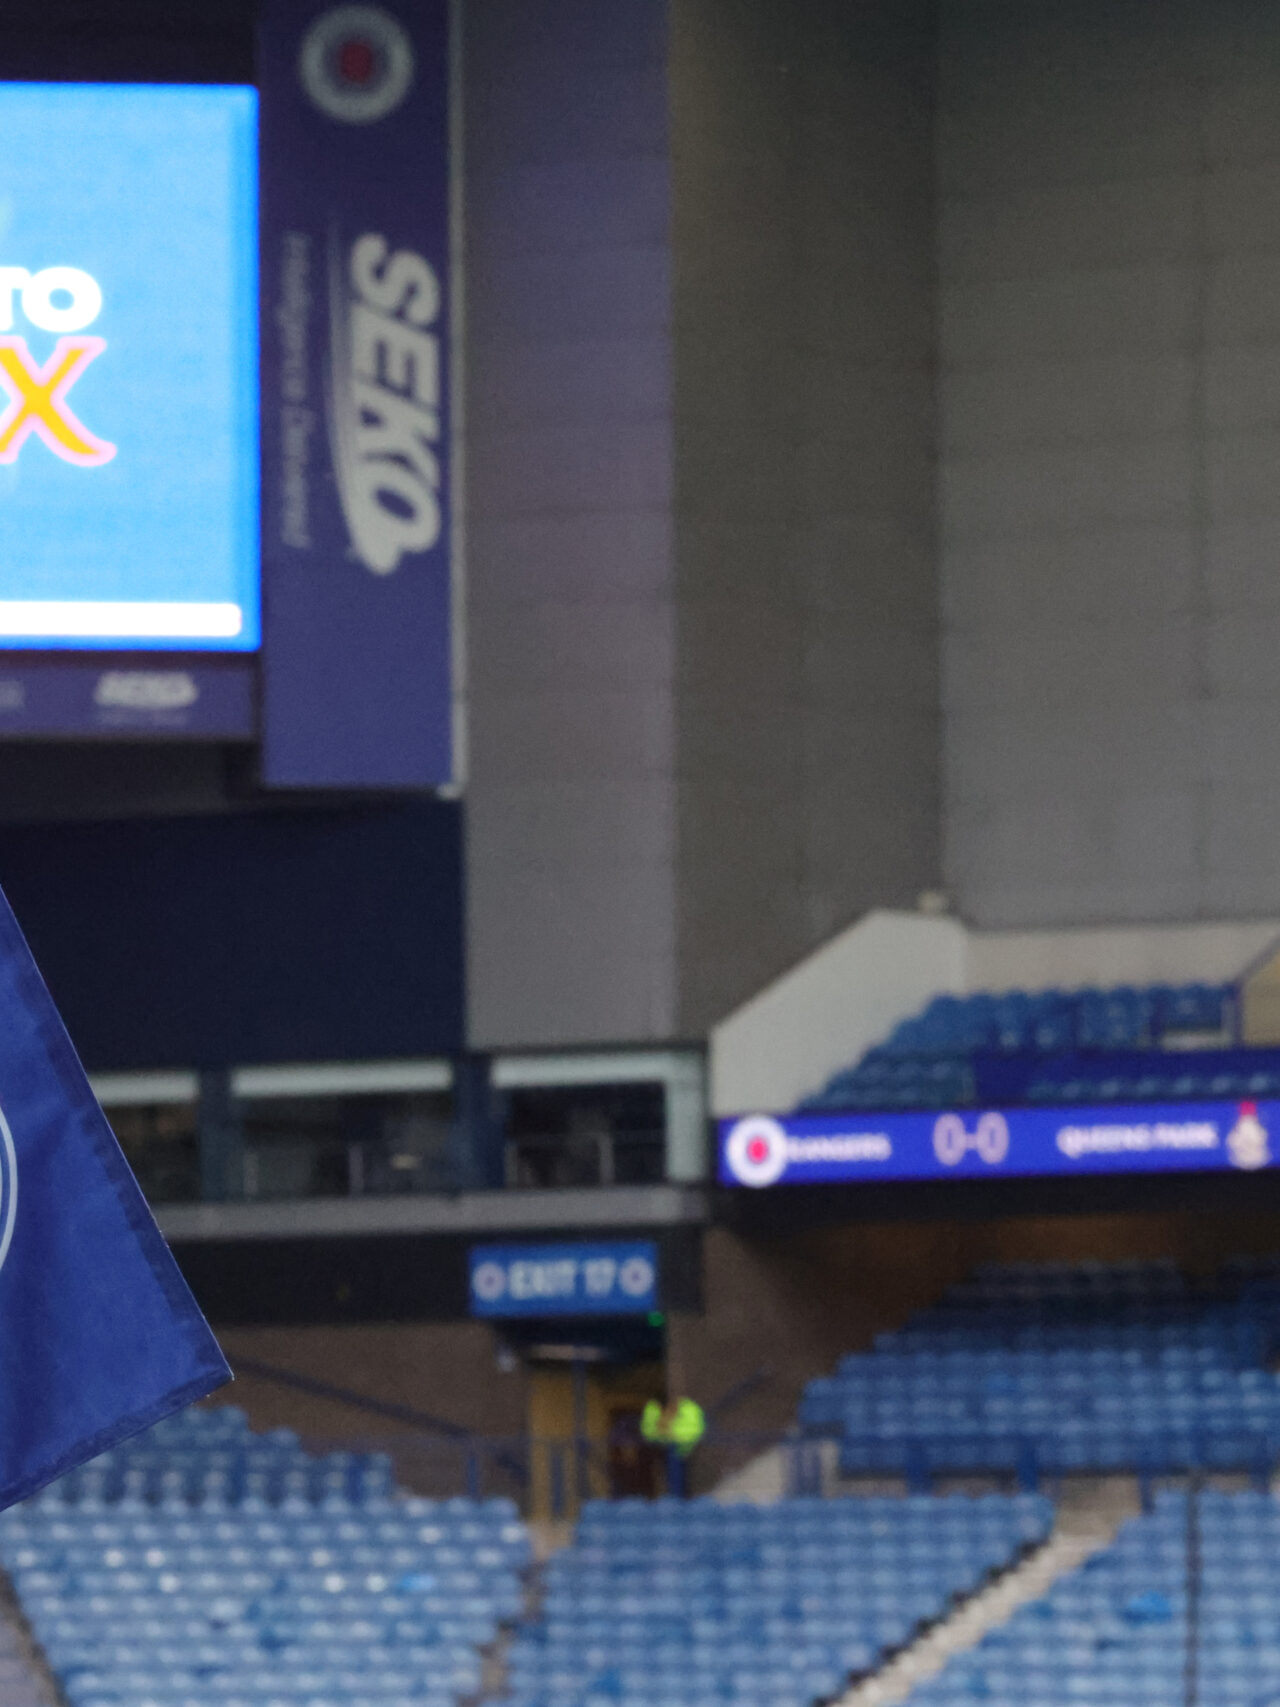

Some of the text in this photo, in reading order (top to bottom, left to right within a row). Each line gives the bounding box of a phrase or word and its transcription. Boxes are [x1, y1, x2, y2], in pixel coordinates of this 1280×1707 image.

[350, 231, 442, 575] SEKO
[508, 1257, 618, 1300] EXIT 17
